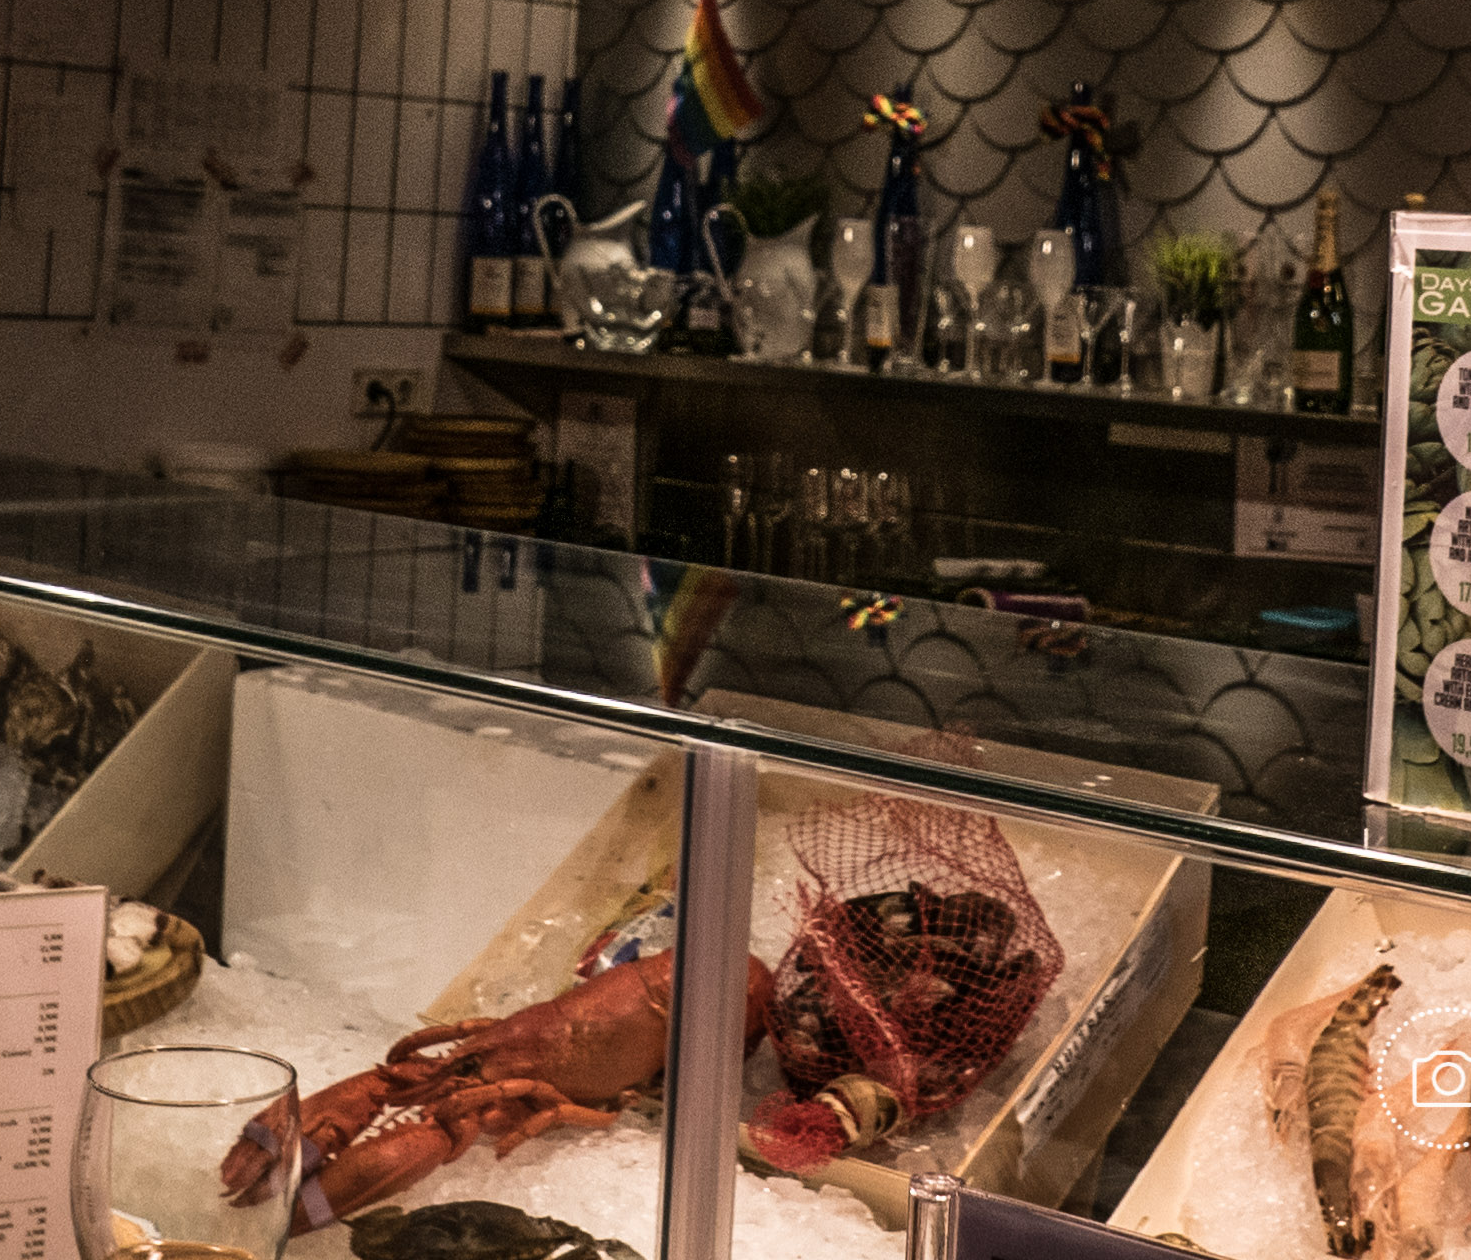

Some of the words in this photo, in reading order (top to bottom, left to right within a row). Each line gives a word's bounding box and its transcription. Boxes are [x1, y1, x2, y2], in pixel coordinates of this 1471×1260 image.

[1452, 396, 1470, 410] AND
[1450, 532, 1471, 549] WITH
[1448, 547, 1466, 563] AND
[1442, 679, 1464, 696] WITH
[1433, 692, 1462, 711] CREAM
